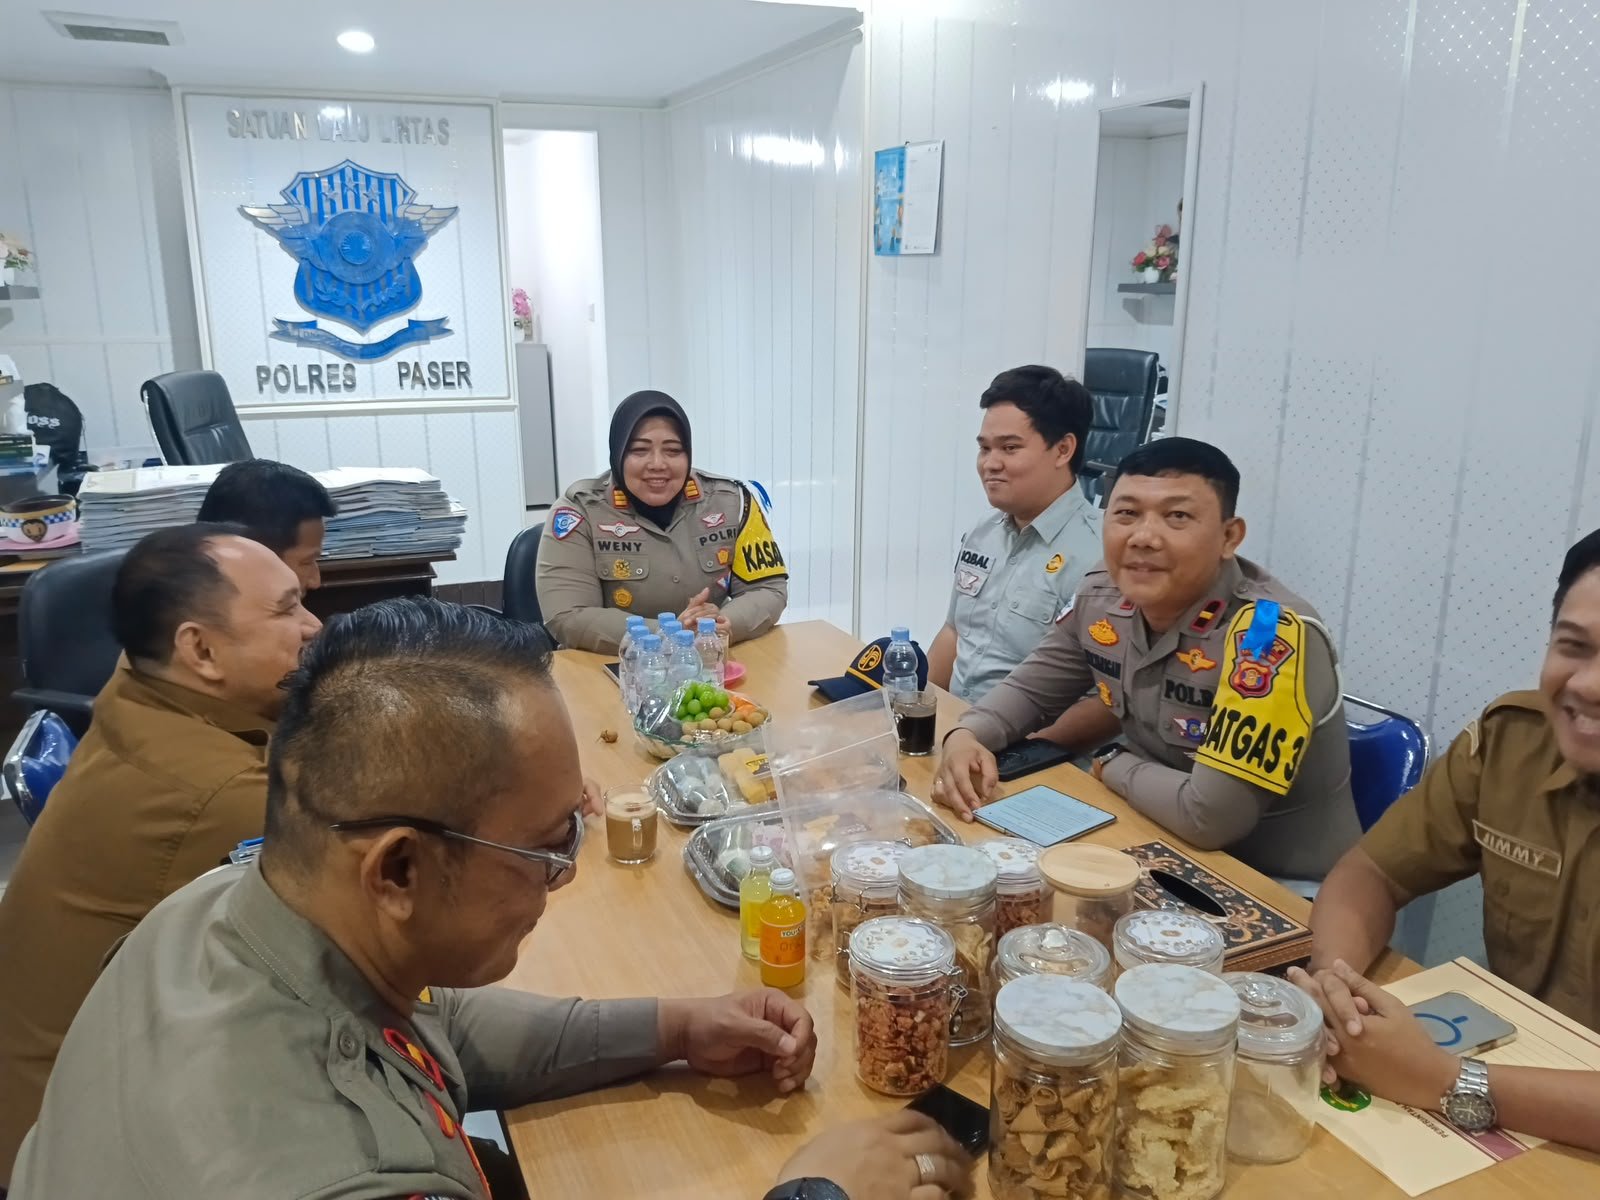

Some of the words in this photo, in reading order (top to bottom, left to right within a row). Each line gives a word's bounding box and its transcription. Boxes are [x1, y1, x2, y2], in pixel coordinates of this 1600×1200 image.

[227, 110, 307, 141] SATUAN
[317, 111, 369, 143] LALU
[381, 116, 449, 145] LINTAS
[257, 363, 356, 394] POLRES
[397, 361, 472, 390] PASER
[598, 541, 642, 552] WENY
[699, 528, 737, 546] POLRI
[961, 550, 989, 569] IQBAL
[1199, 704, 1287, 773] SATGAS
[1284, 736, 1305, 781] 3
[1482, 831, 1544, 868] JIMMY
